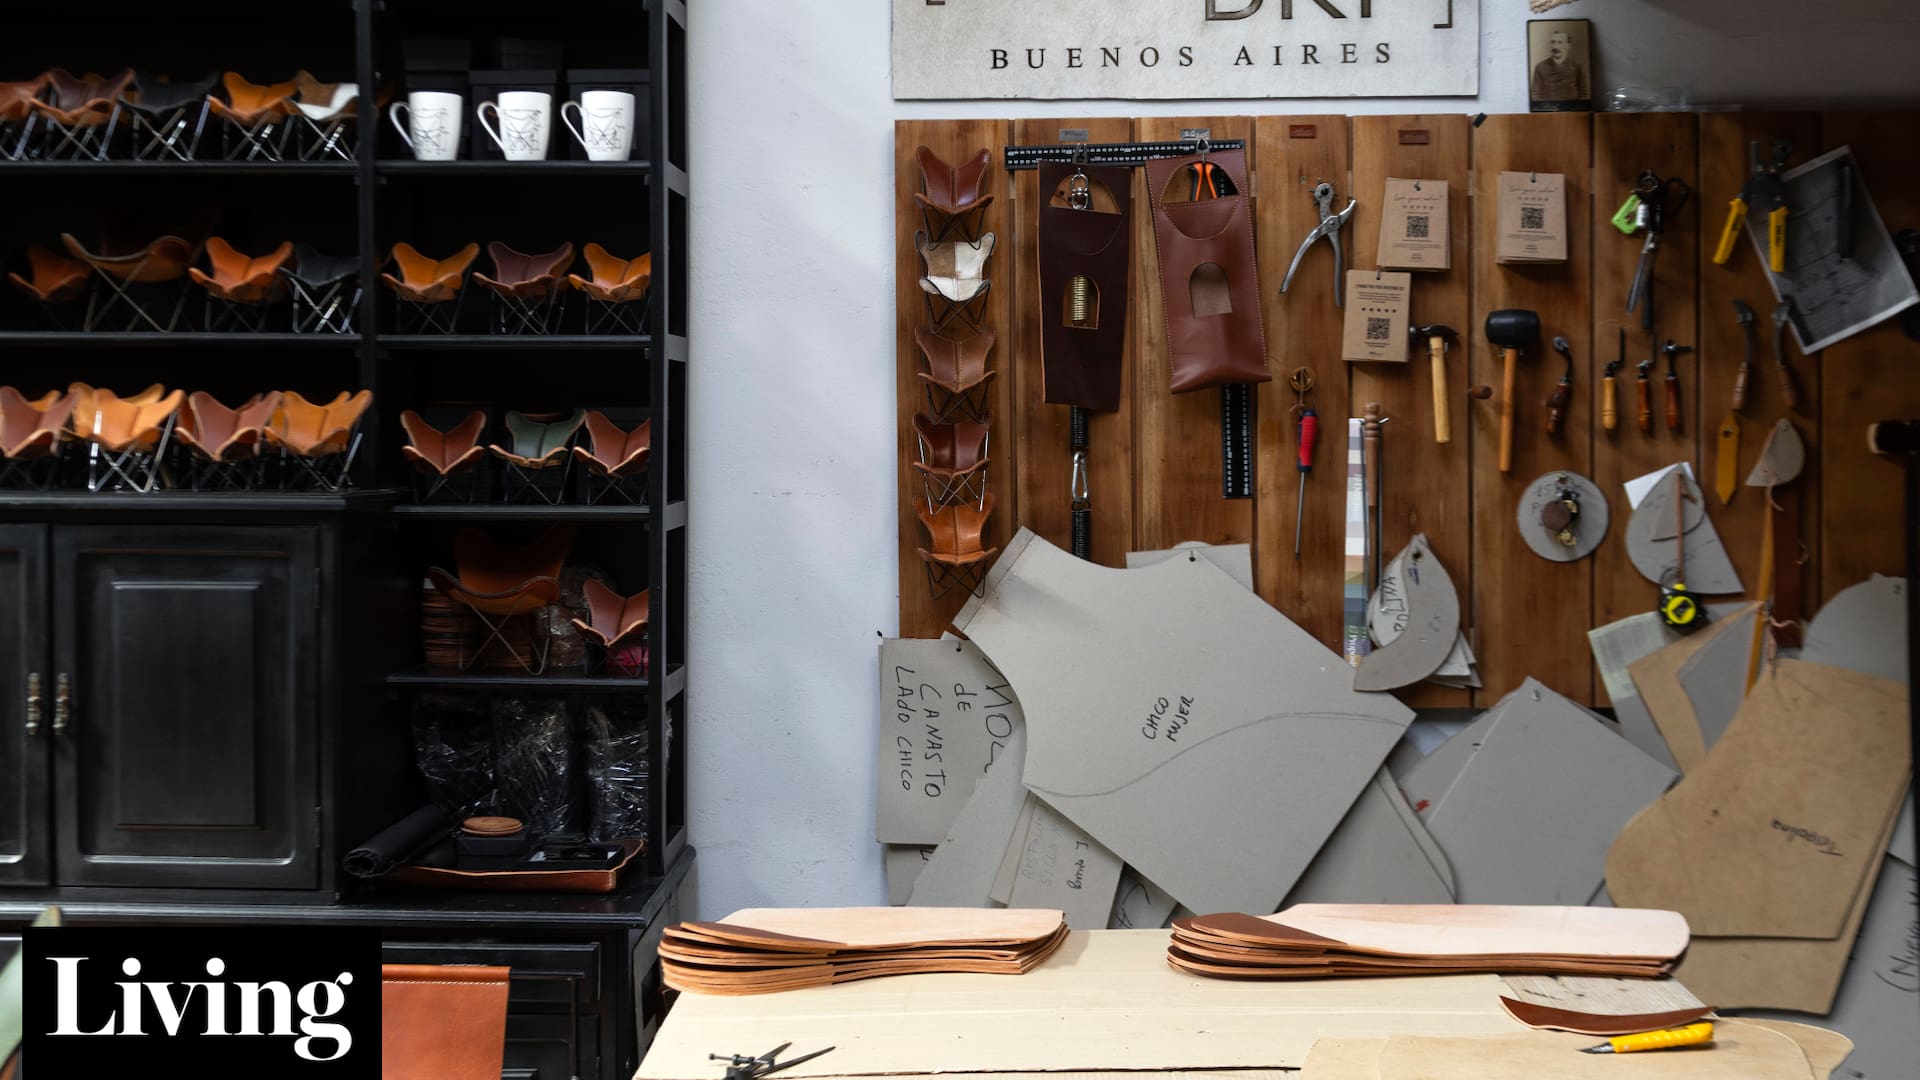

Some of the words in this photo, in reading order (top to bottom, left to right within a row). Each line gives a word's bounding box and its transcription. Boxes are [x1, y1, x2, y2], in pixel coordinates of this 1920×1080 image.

[989, 45, 1194, 71] BUENOS
[1232, 42, 1391, 67] AIRES
[919, 683, 947, 798] CANASTO
[983, 657, 1014, 773] MOL
[1141, 696, 1169, 740] CHICO
[1166, 695, 1195, 743] MUJER
[896, 735, 914, 792] CHICO
